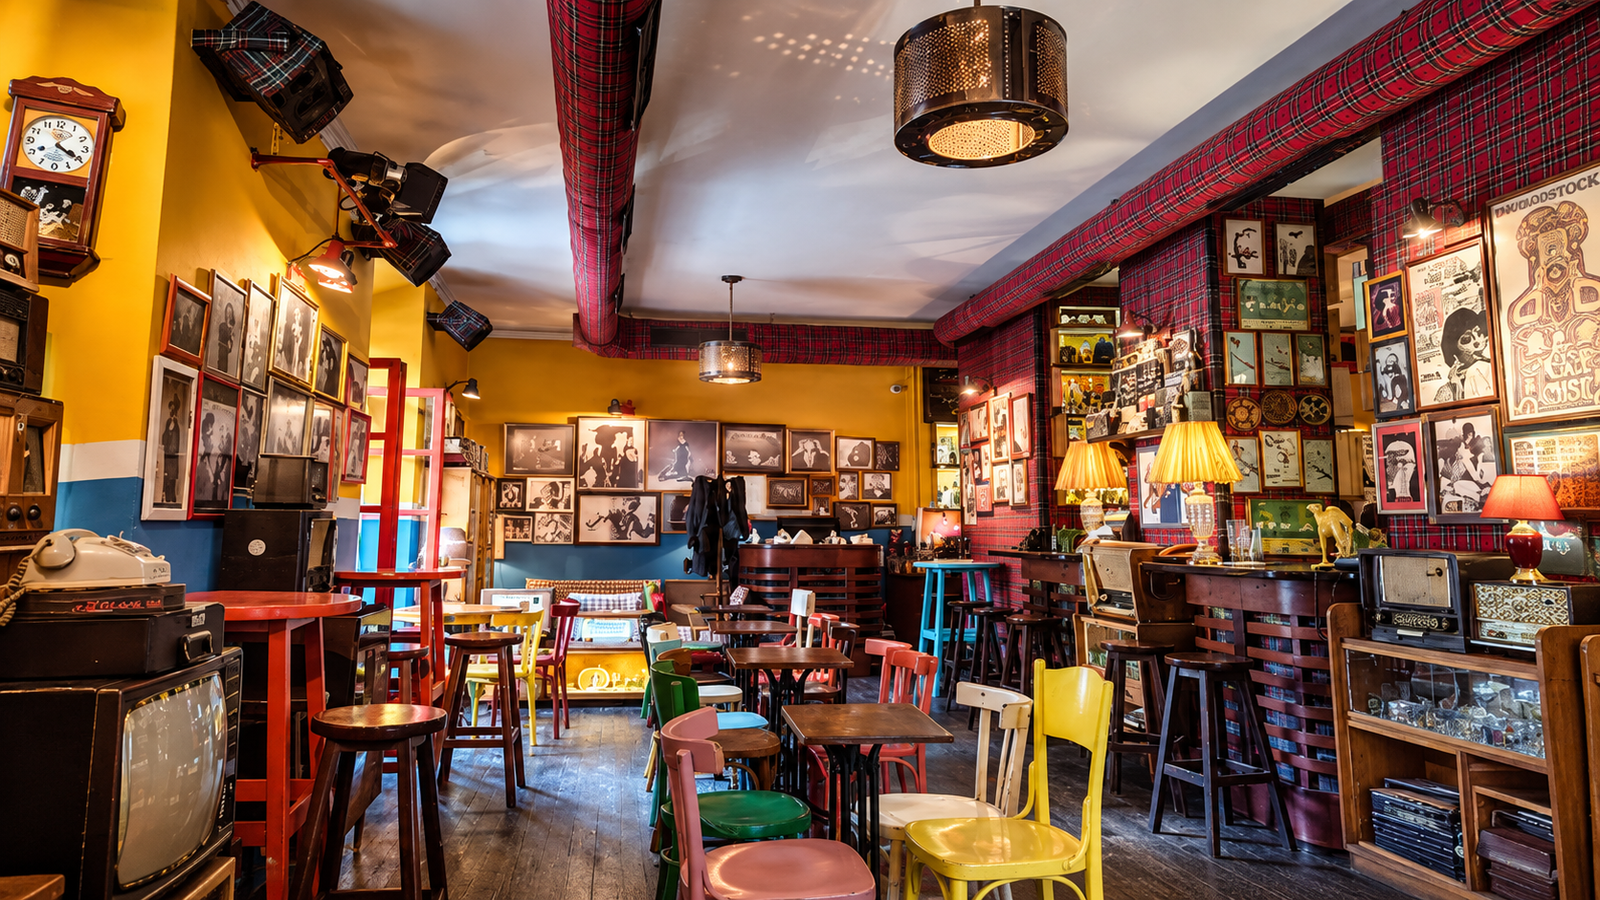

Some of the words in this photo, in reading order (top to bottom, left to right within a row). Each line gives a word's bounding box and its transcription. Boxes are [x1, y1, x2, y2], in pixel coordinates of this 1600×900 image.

[44, 121, 51, 129] 11
[56, 120, 66, 129] 12
[81, 145, 89, 153] 3
